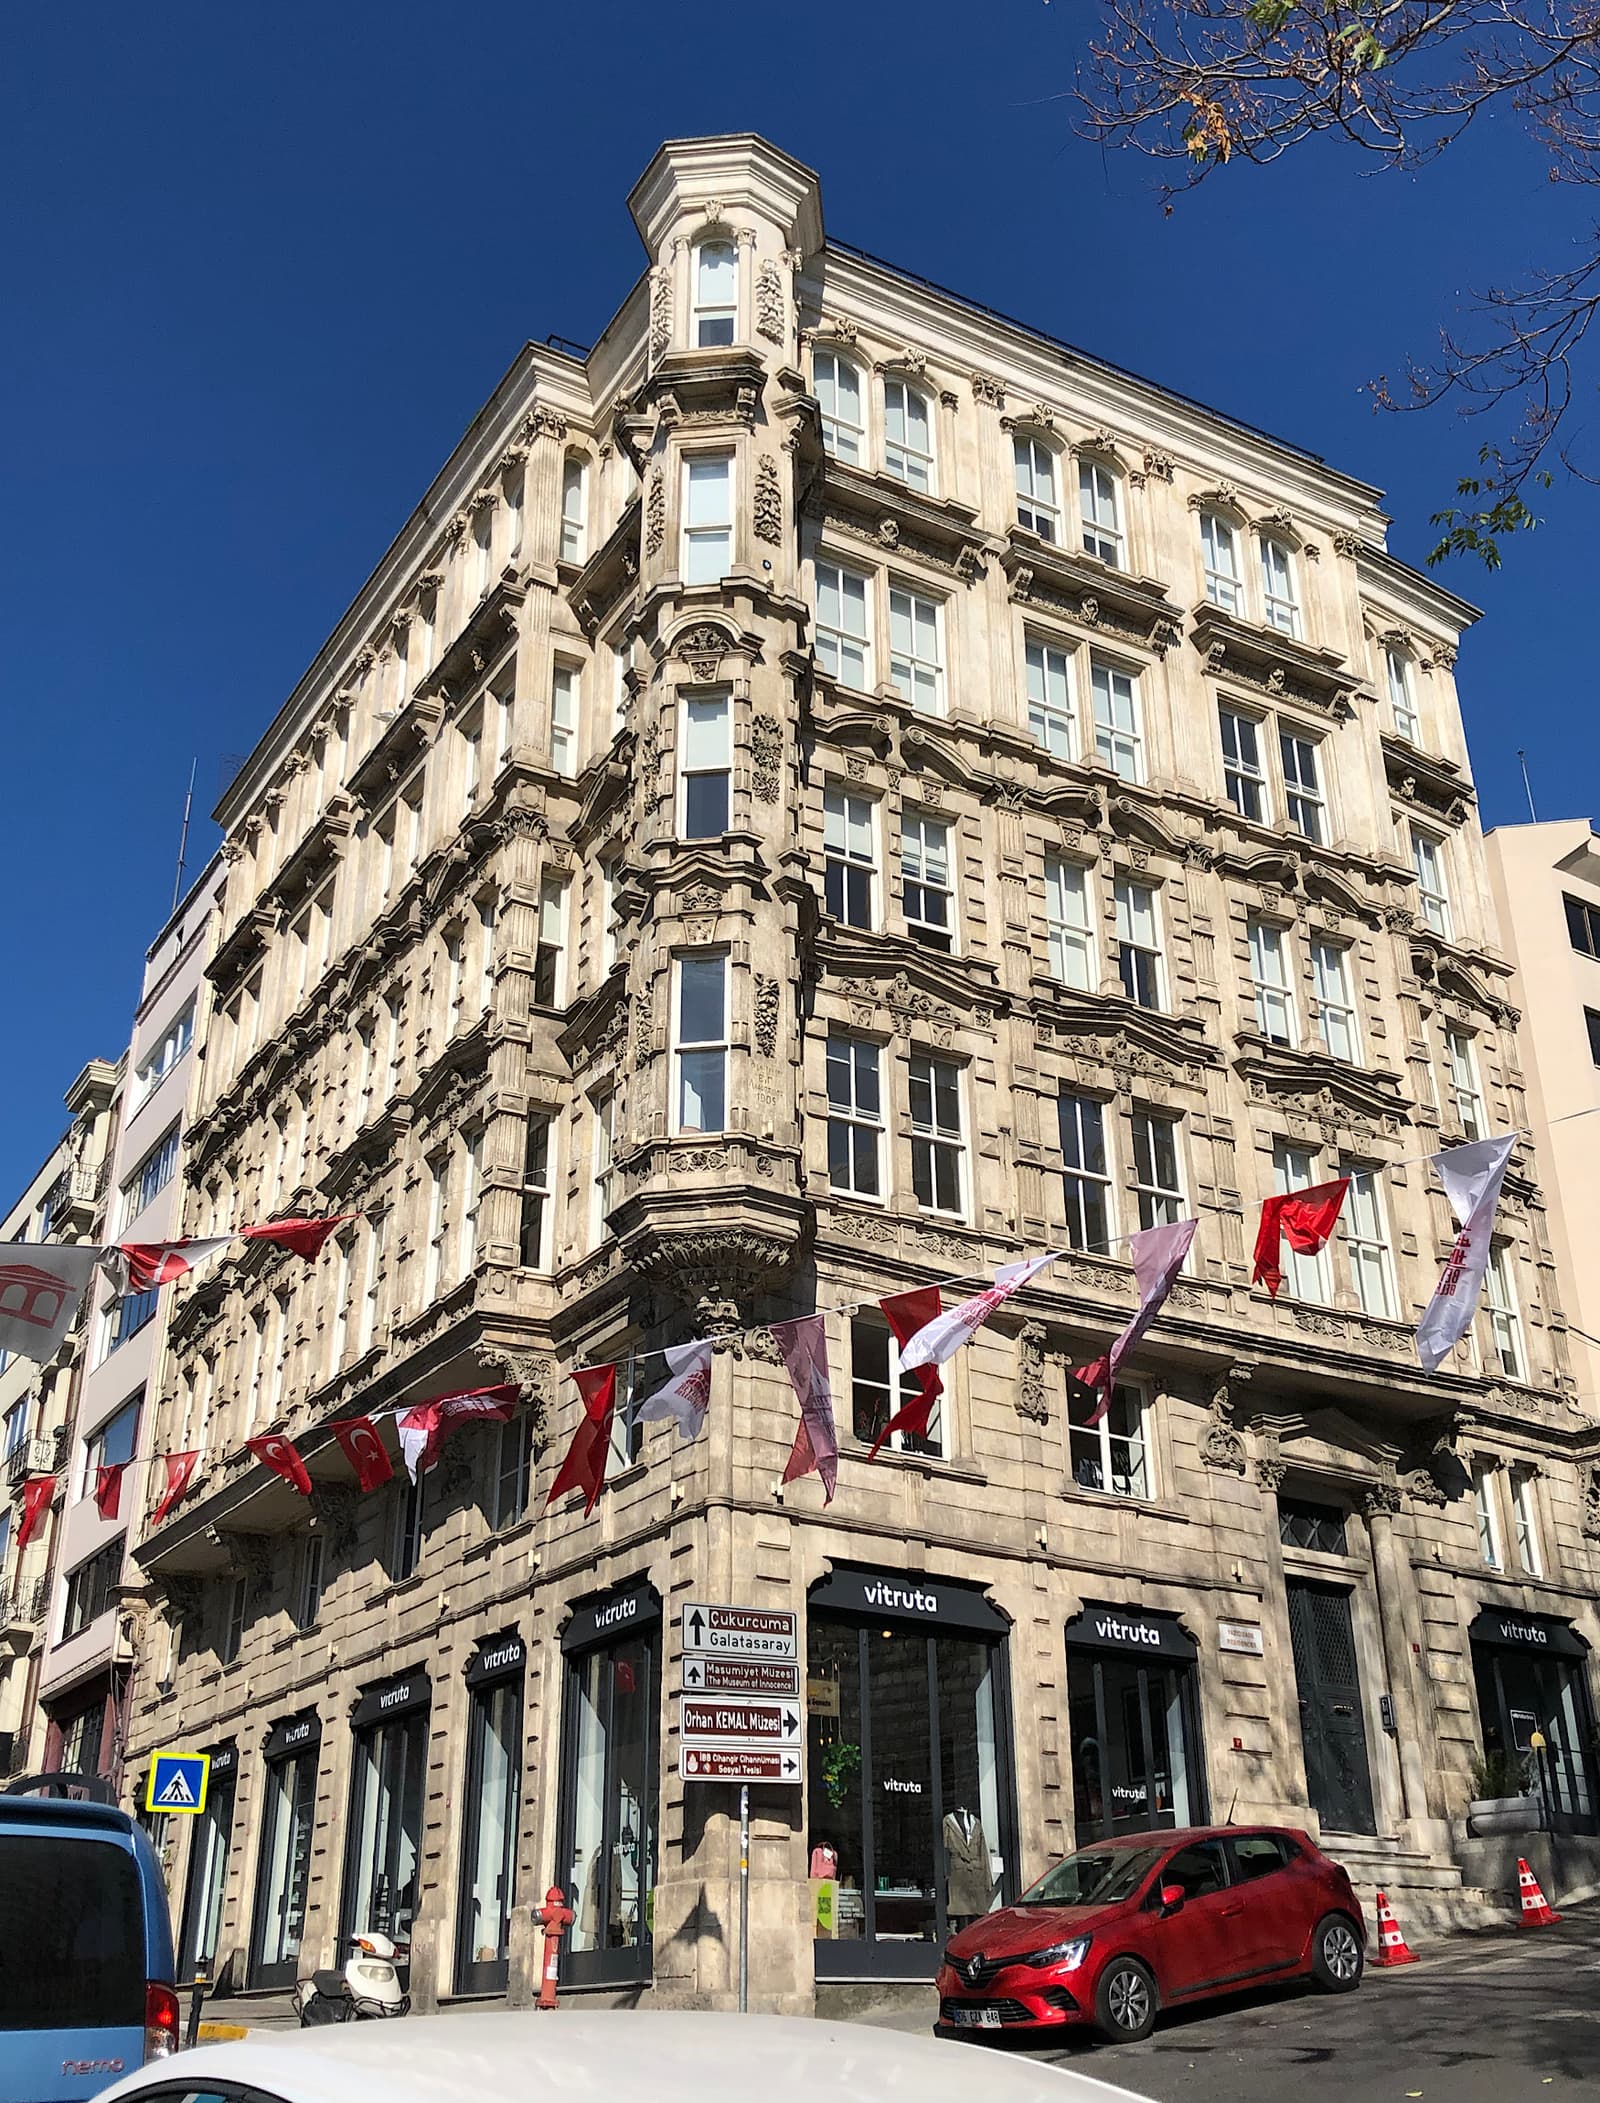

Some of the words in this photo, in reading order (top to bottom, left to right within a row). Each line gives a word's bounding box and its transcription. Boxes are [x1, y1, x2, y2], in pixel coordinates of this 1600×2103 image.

[864, 1581, 938, 1612] vitruta
[595, 1598, 636, 1629] vitruta
[710, 1610, 790, 1631] Çukurcuma
[1095, 1616, 1161, 1645] vitruta
[1500, 1620, 1547, 1643] vitruta
[710, 1632, 791, 1654] Galatasaray
[483, 1643, 520, 1670] vitruta
[706, 1663, 759, 1678] Masumiyet
[761, 1667, 793, 1679] Müzesi
[706, 1675, 720, 1686] (The
[721, 1676, 750, 1687] Museum
[751, 1678, 758, 1688] of
[759, 1679, 794, 1690] Innocence)
[380, 1684, 410, 1708] vitruta
[685, 1711, 713, 1729] Orhan
[715, 1712, 748, 1730] KEMAL
[749, 1712, 780, 1732] Müzesi
[712, 1754, 738, 1765] Cihangir
[718, 1765, 741, 1776] Sosyal
[742, 1766, 762, 1775] Tesisi
[883, 1777, 922, 1793] vitruta
[1111, 1786, 1147, 1799] vitruta
[62, 2057, 125, 2077] nemo
